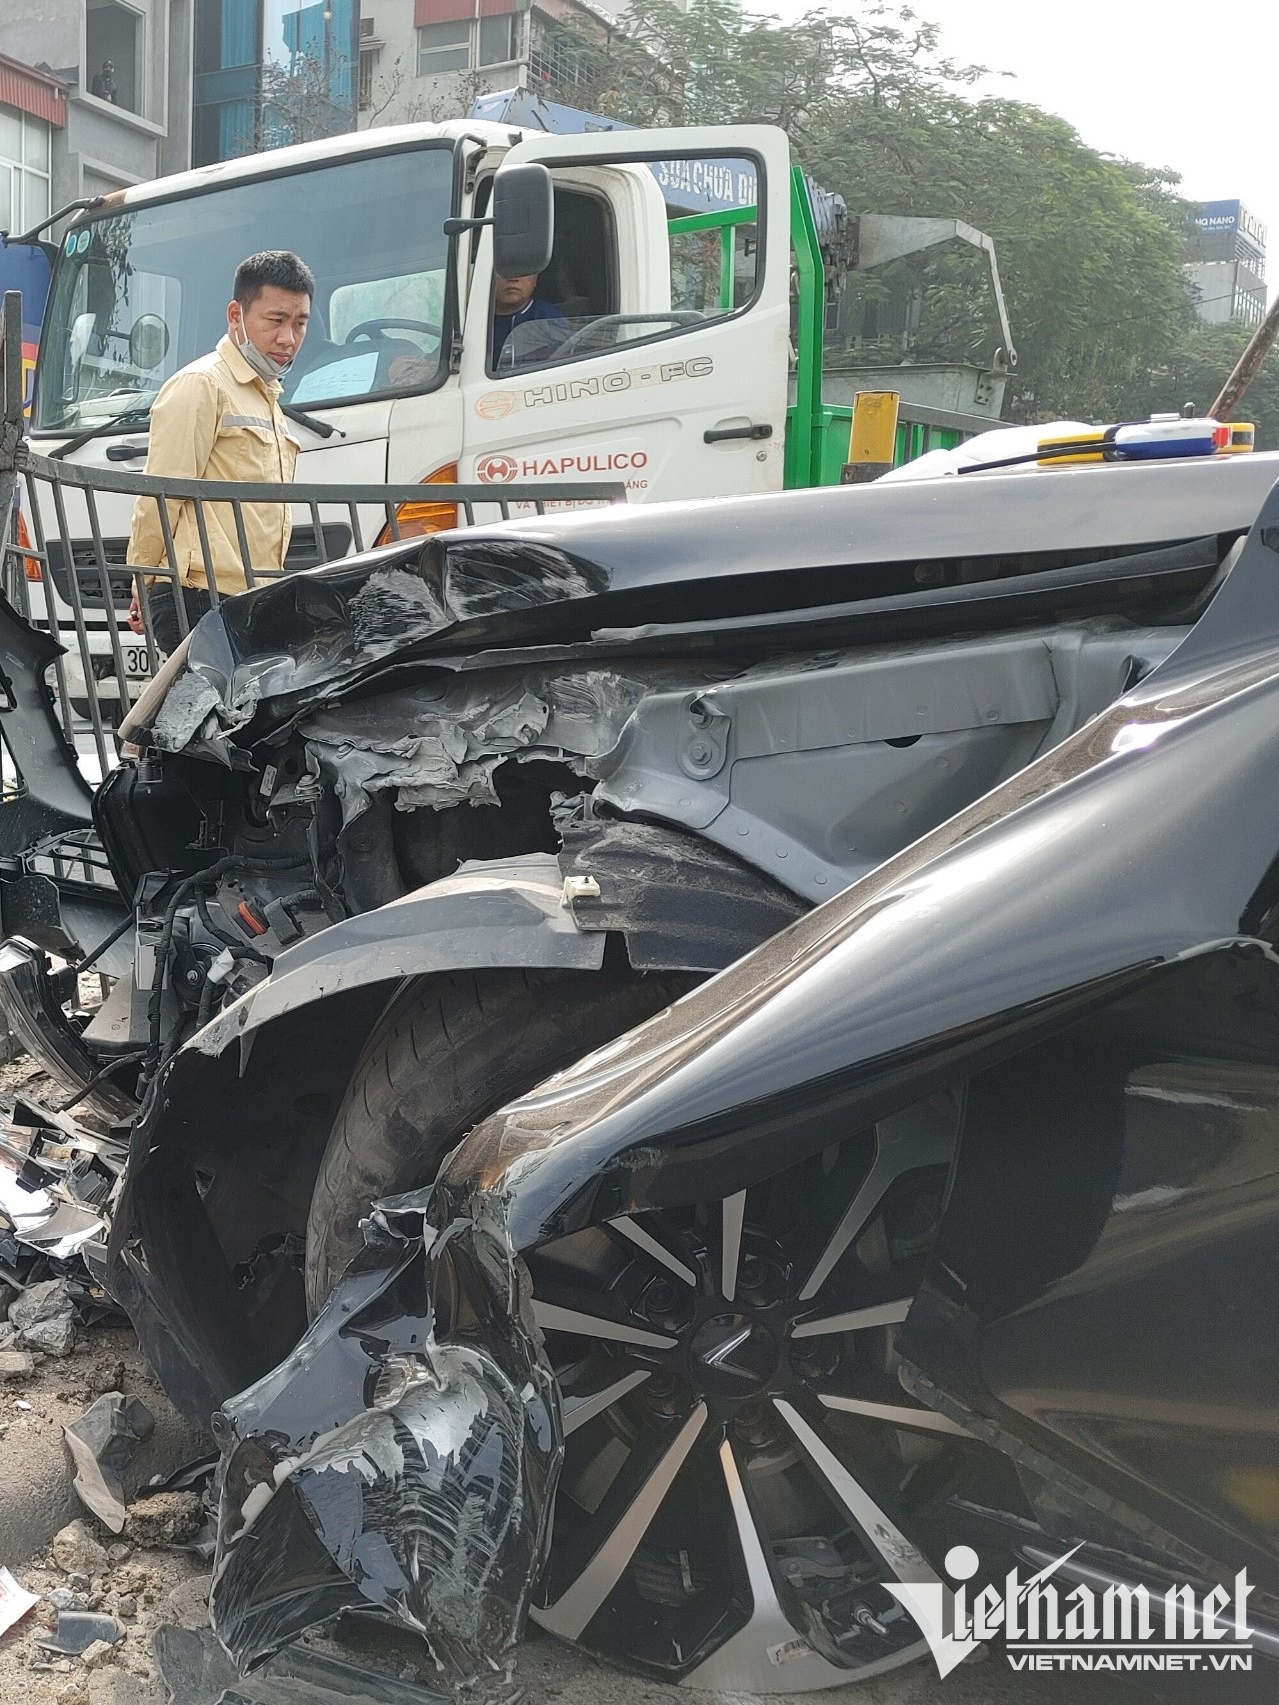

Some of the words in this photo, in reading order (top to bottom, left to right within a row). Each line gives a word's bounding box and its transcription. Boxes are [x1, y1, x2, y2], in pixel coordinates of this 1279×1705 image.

[1209, 216, 1235, 226] NANO
[523, 371, 632, 408] HINO
[659, 356, 714, 382] FC
[522, 452, 648, 477] HAPULICO
